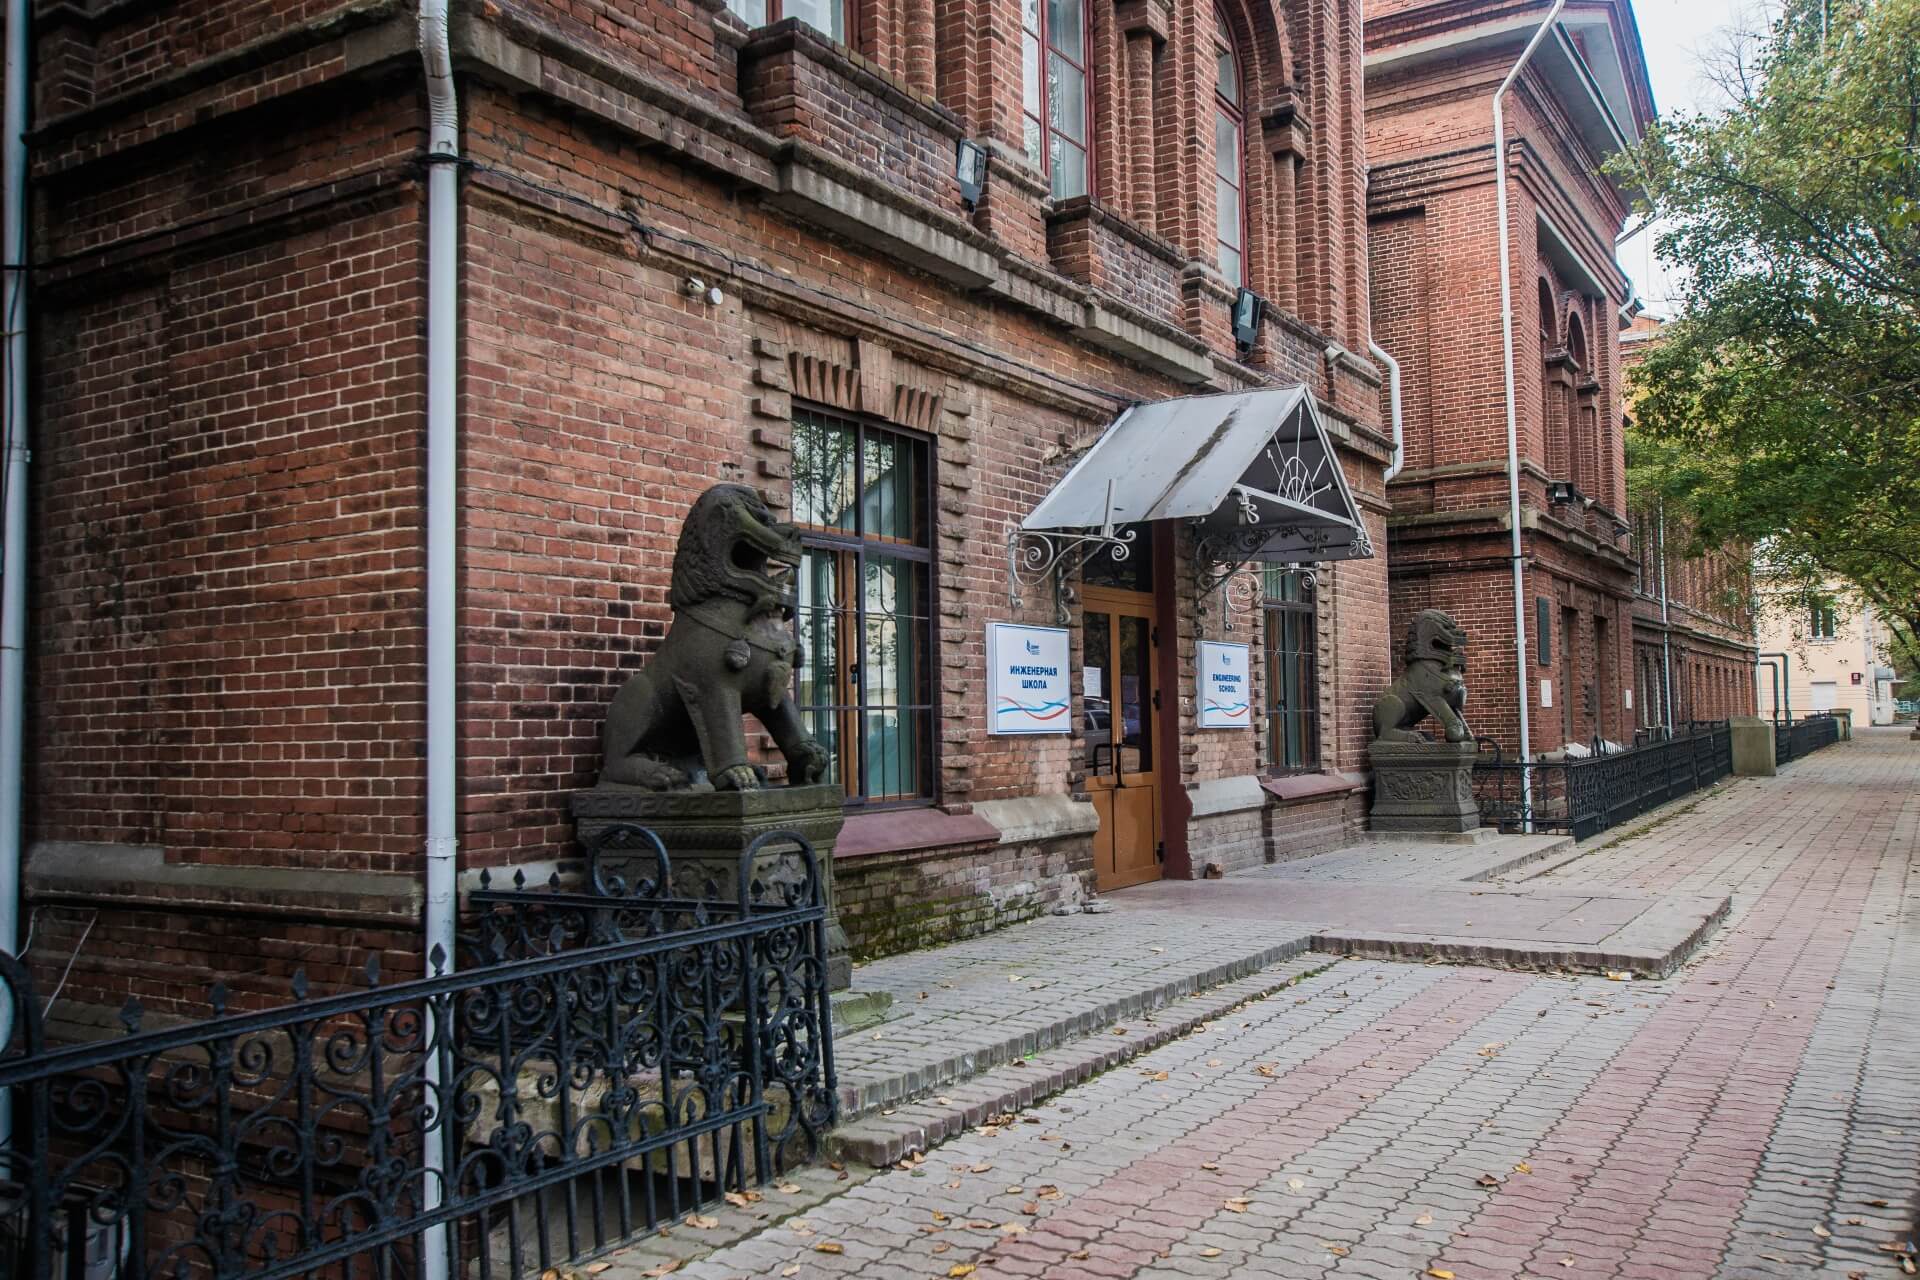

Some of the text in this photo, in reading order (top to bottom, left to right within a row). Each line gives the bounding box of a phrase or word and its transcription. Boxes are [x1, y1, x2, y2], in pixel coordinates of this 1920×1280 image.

[1010, 665, 1058, 677] ИНЖЕНЕРНАЯ
[1212, 673, 1241, 682] ENGINEERING
[1022, 679, 1047, 689] ШКОЛА
[1219, 684, 1236, 693] SCHOOL
